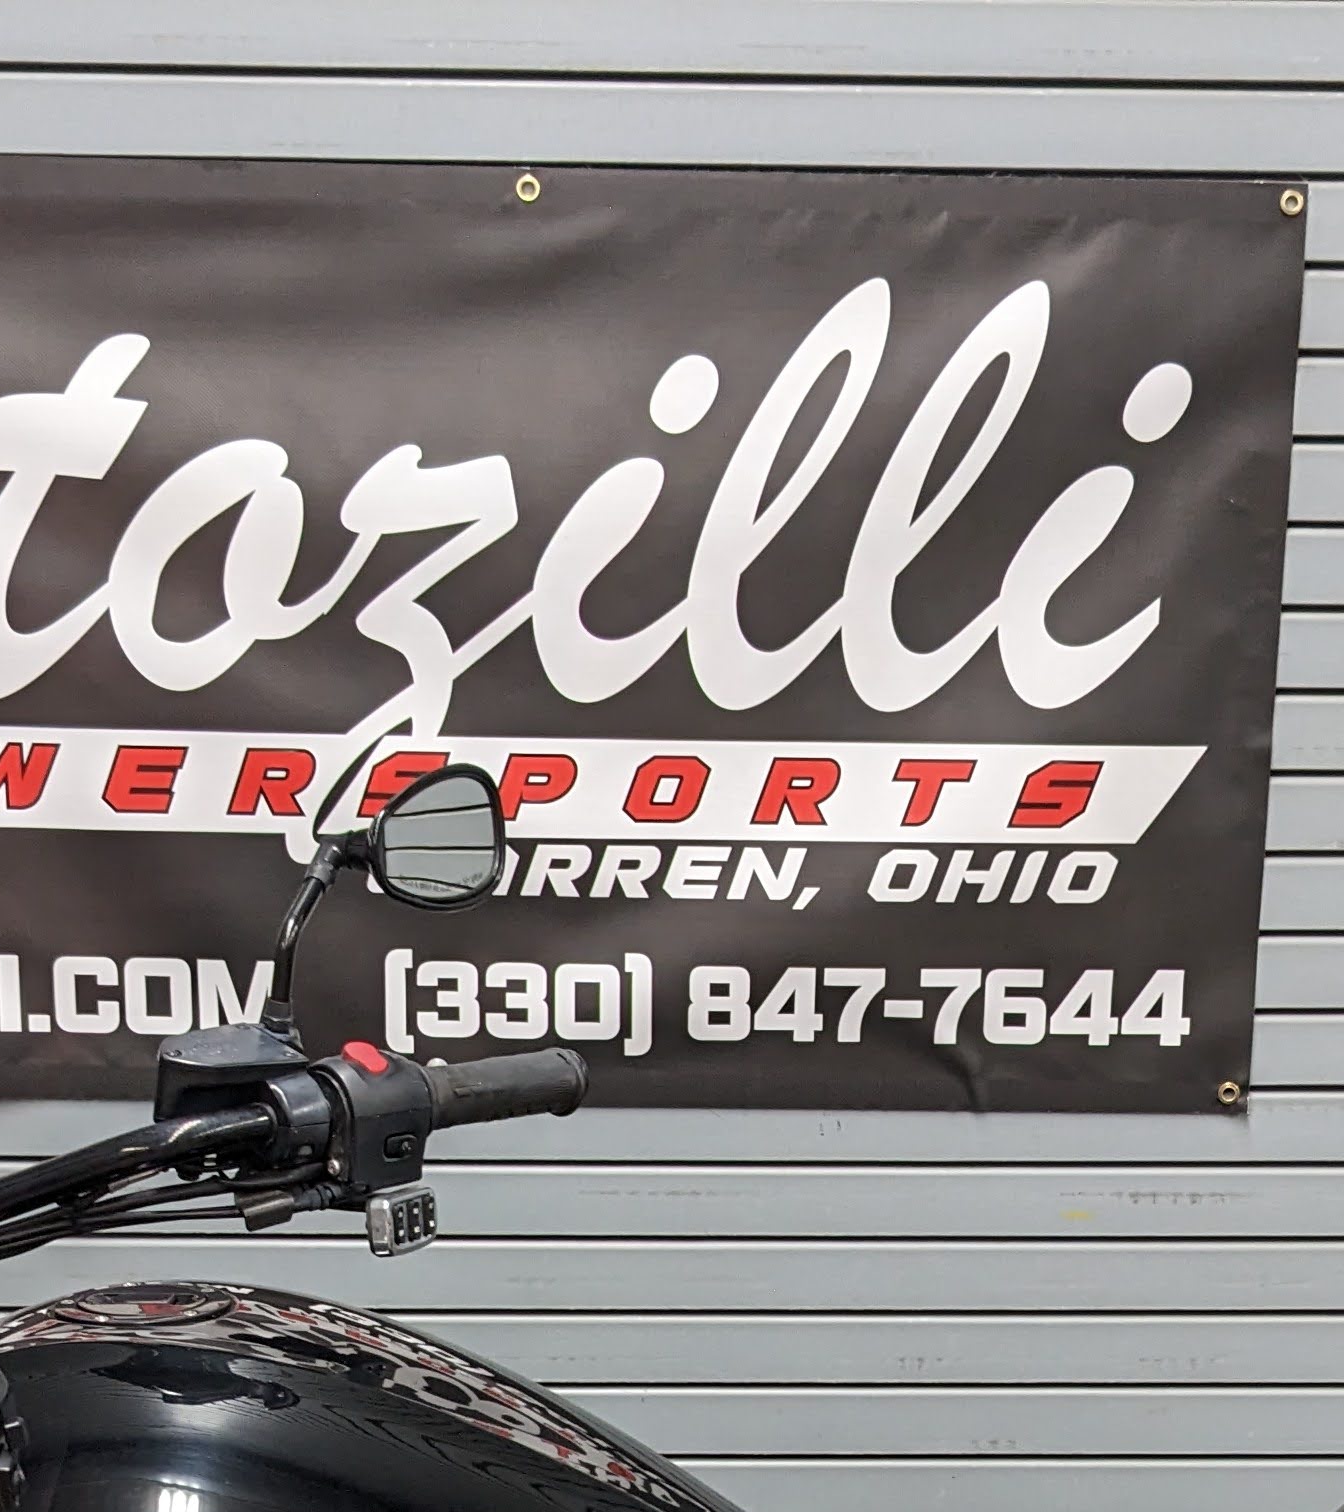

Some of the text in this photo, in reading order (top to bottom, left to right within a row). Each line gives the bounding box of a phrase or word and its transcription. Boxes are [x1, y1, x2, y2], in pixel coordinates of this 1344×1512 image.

[367, 844, 1119, 910] RREN, OHIO
[384, 951, 653, 1057] (330)
[686, 965, 1192, 1047] 847-7644
